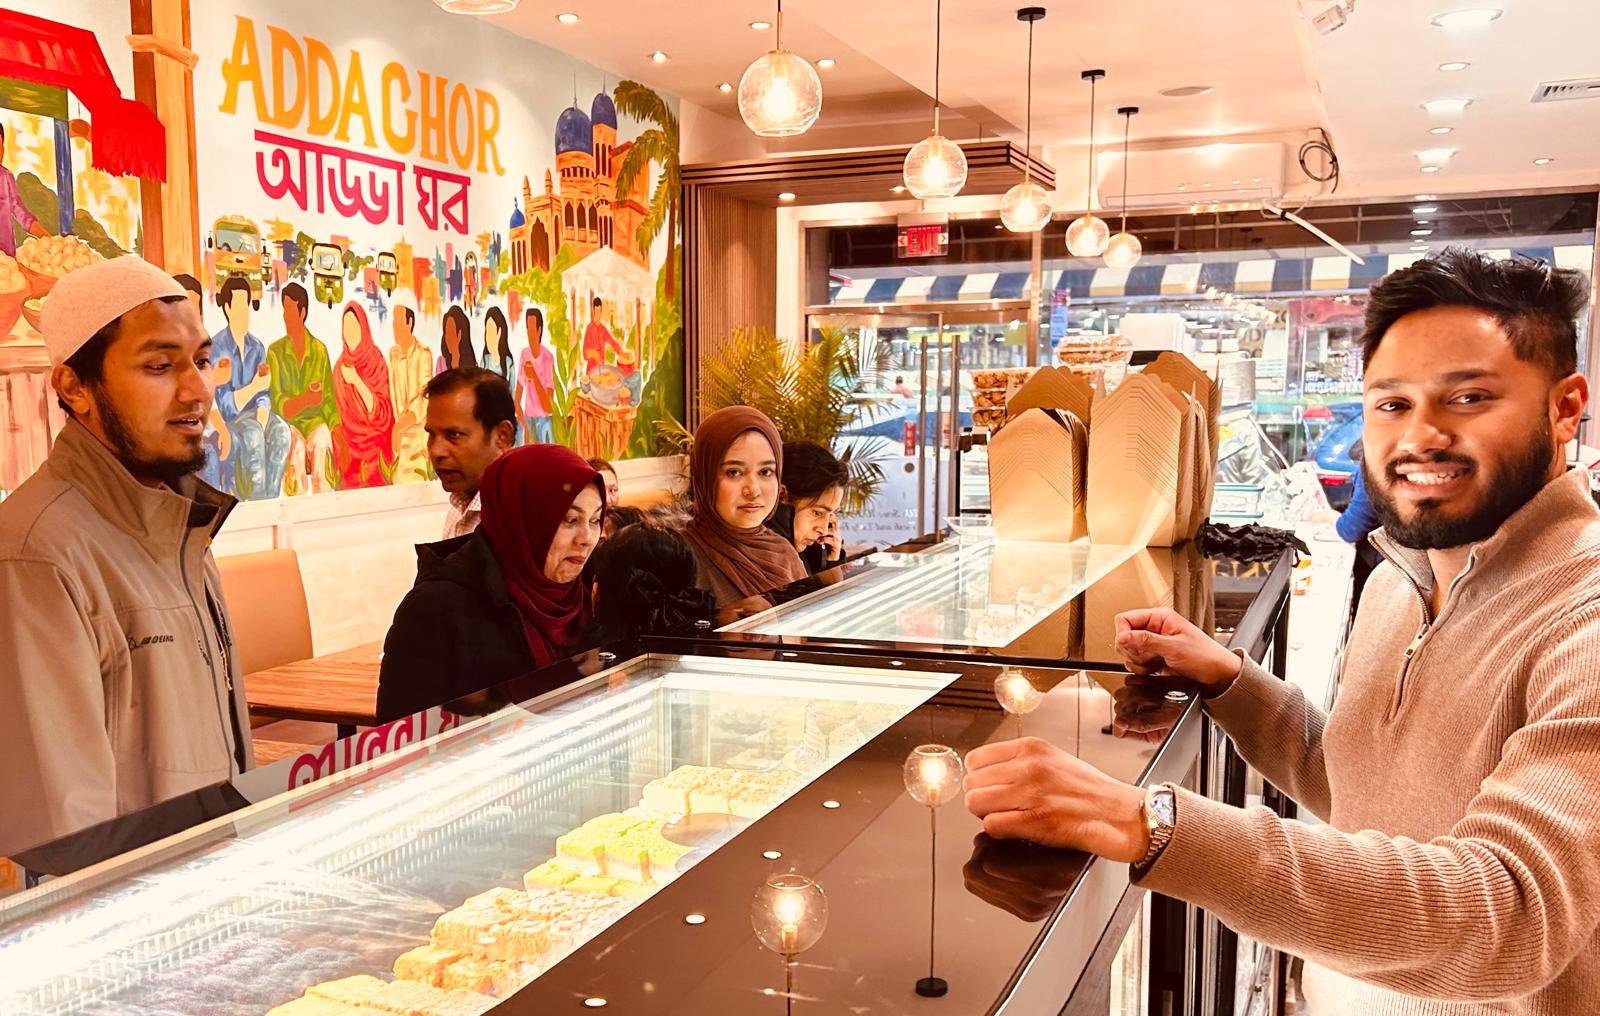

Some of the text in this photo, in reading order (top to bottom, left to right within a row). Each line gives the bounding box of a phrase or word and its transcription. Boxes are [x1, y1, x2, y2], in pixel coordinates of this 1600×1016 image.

[217, 14, 505, 176] ADDA GHOR
[254, 129, 471, 236] আড্ডা ঘর
[907, 226, 941, 255] EXIT
